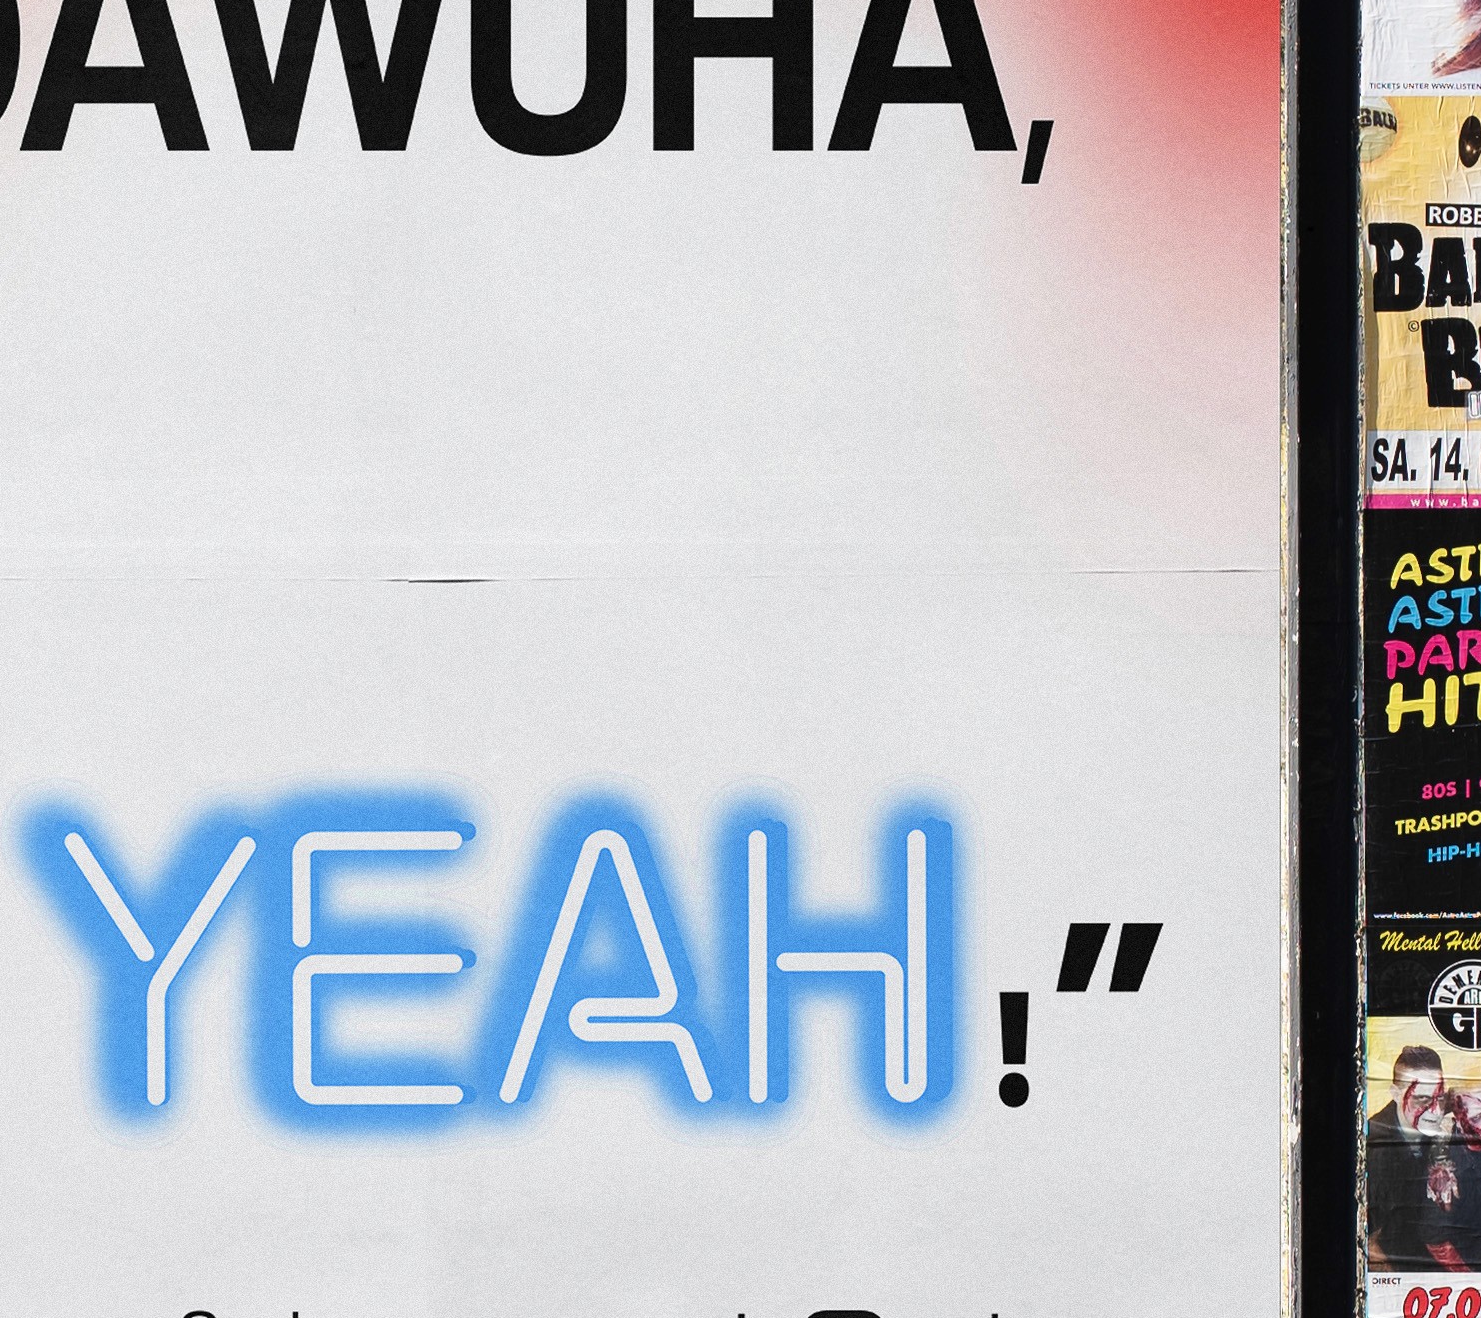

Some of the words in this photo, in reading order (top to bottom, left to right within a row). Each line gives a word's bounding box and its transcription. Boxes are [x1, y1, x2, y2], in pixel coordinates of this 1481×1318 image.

[1422, 781, 1457, 800] 80S
[1380, 930, 1441, 952] Mental
[1444, 930, 1481, 952] Hell
